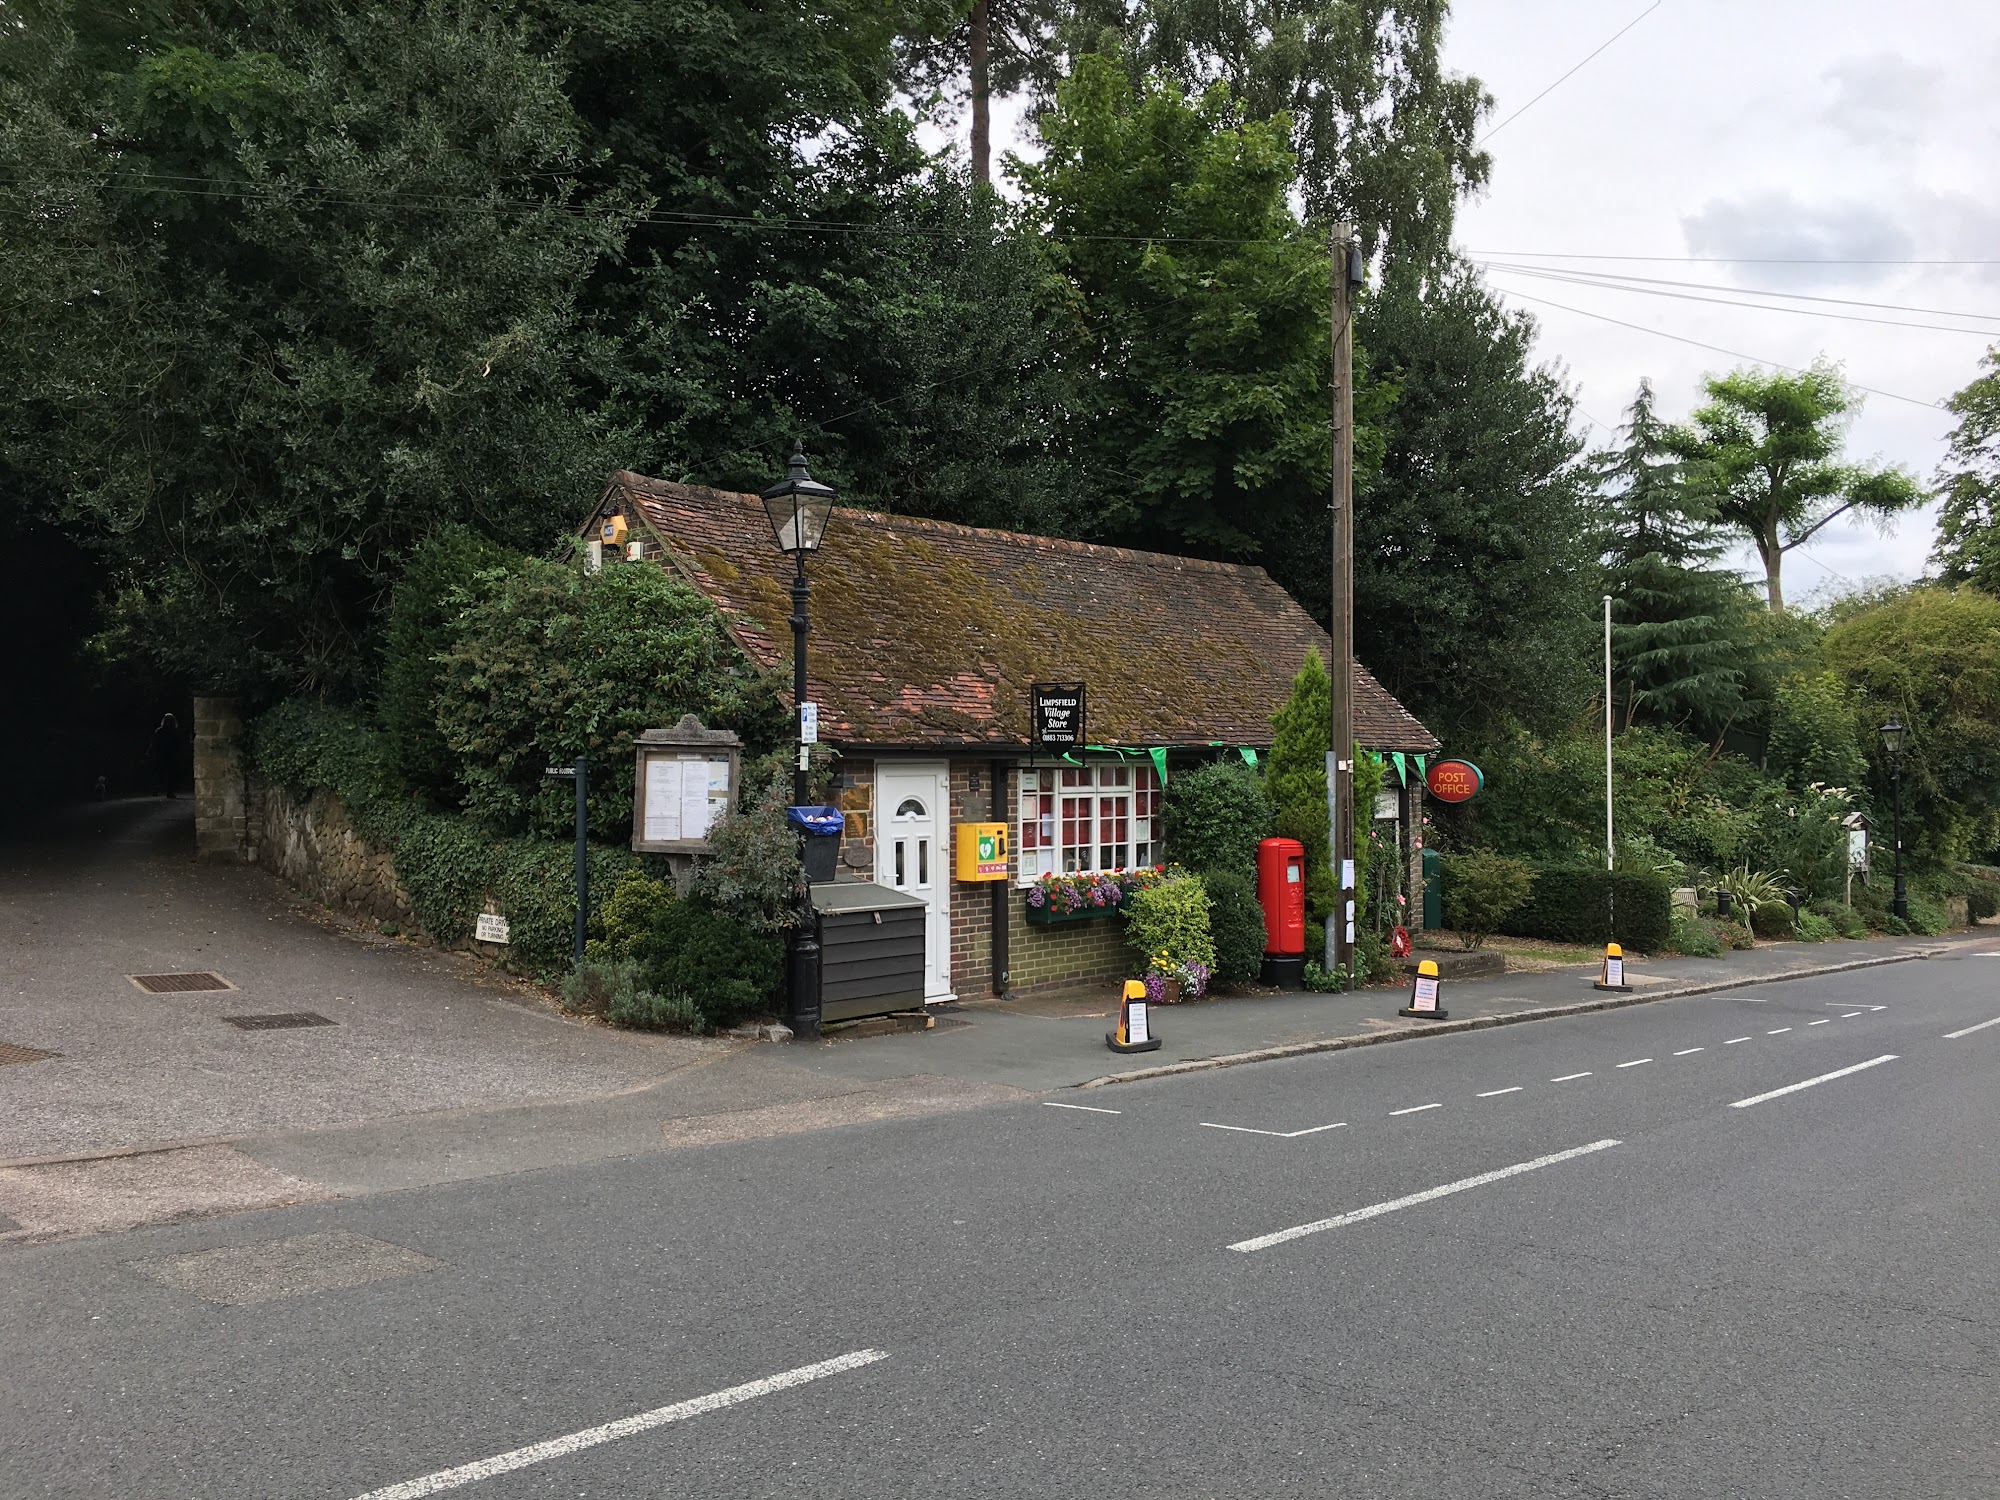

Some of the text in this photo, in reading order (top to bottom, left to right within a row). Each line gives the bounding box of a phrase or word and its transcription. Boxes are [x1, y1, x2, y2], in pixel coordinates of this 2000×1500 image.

[1039, 696, 1077, 707] LIMPSFIELD
[1044, 707, 1070, 720] Village
[1047, 718, 1068, 729] Store
[1042, 734, 1075, 742] 01883 713306
[1438, 772, 1466, 783] POST
[1433, 783, 1470, 794] OFFICE
[488, 926, 504, 934] PARKING
